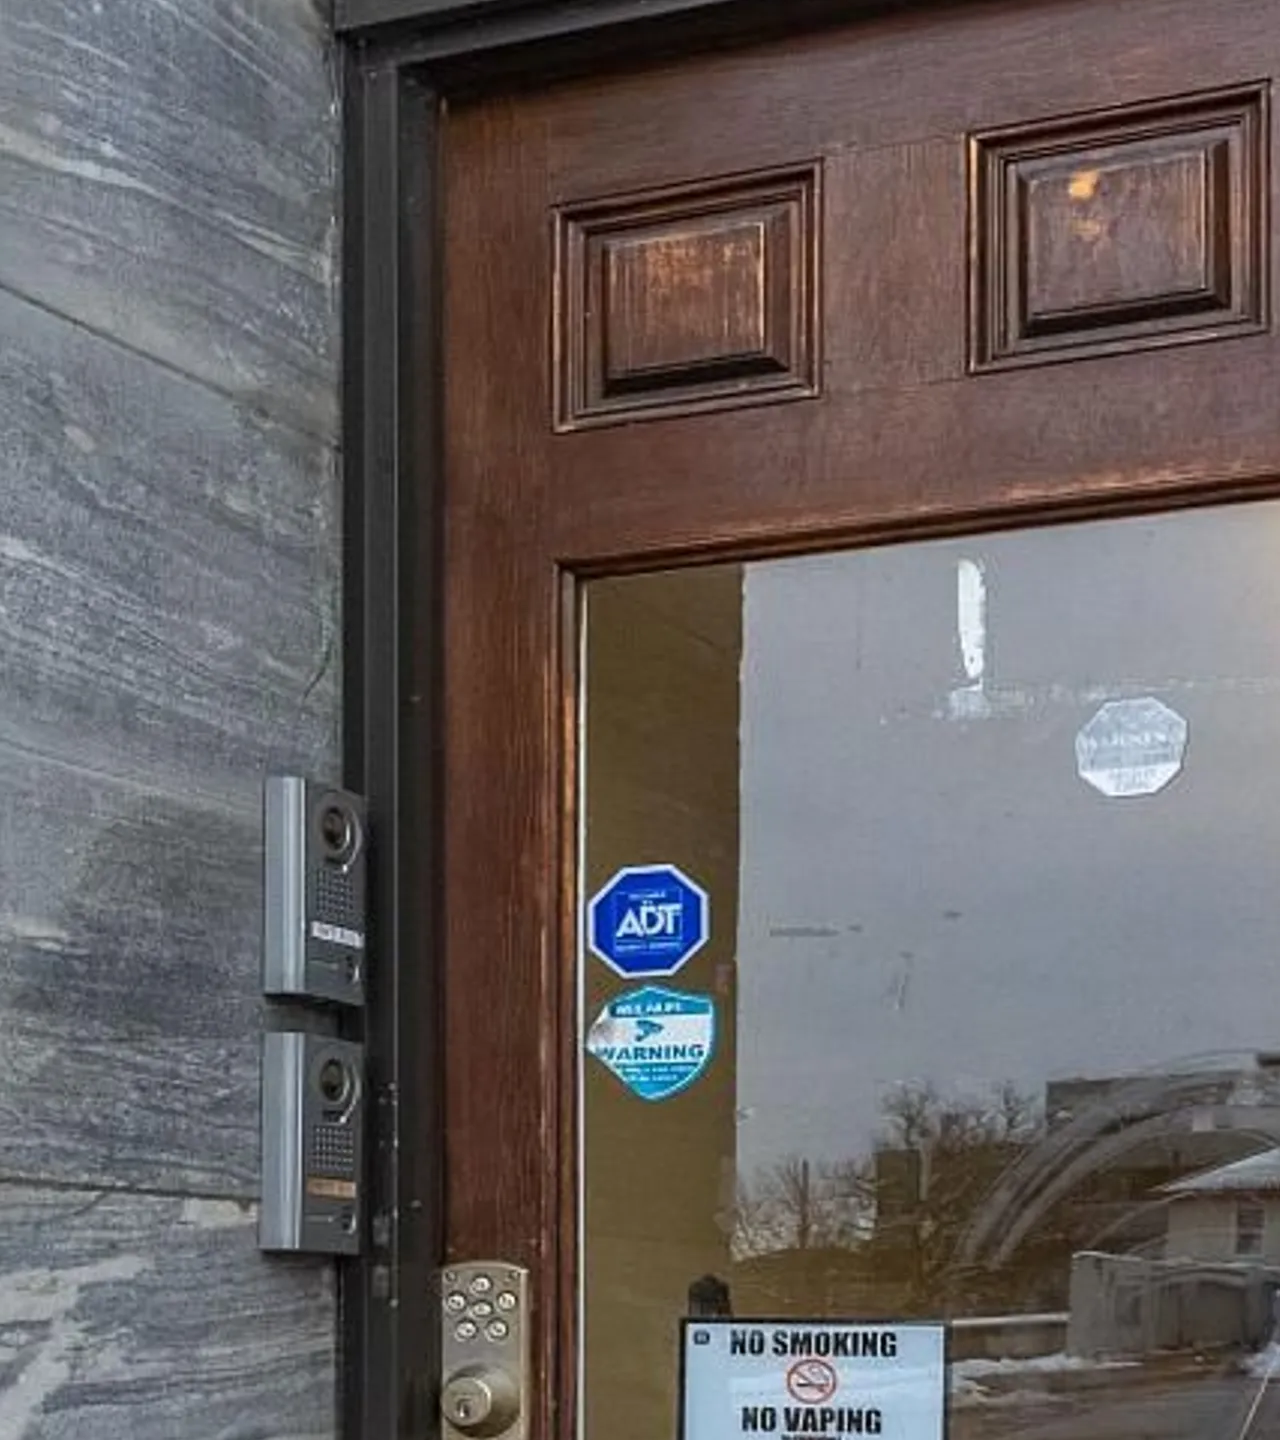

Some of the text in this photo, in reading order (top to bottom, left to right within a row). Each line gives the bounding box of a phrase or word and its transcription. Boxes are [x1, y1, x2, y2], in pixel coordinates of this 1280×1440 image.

[615, 902, 682, 938] ADT
[730, 1329, 897, 1358] NO SMOKING
[741, 1406, 882, 1435] NO VAPING
